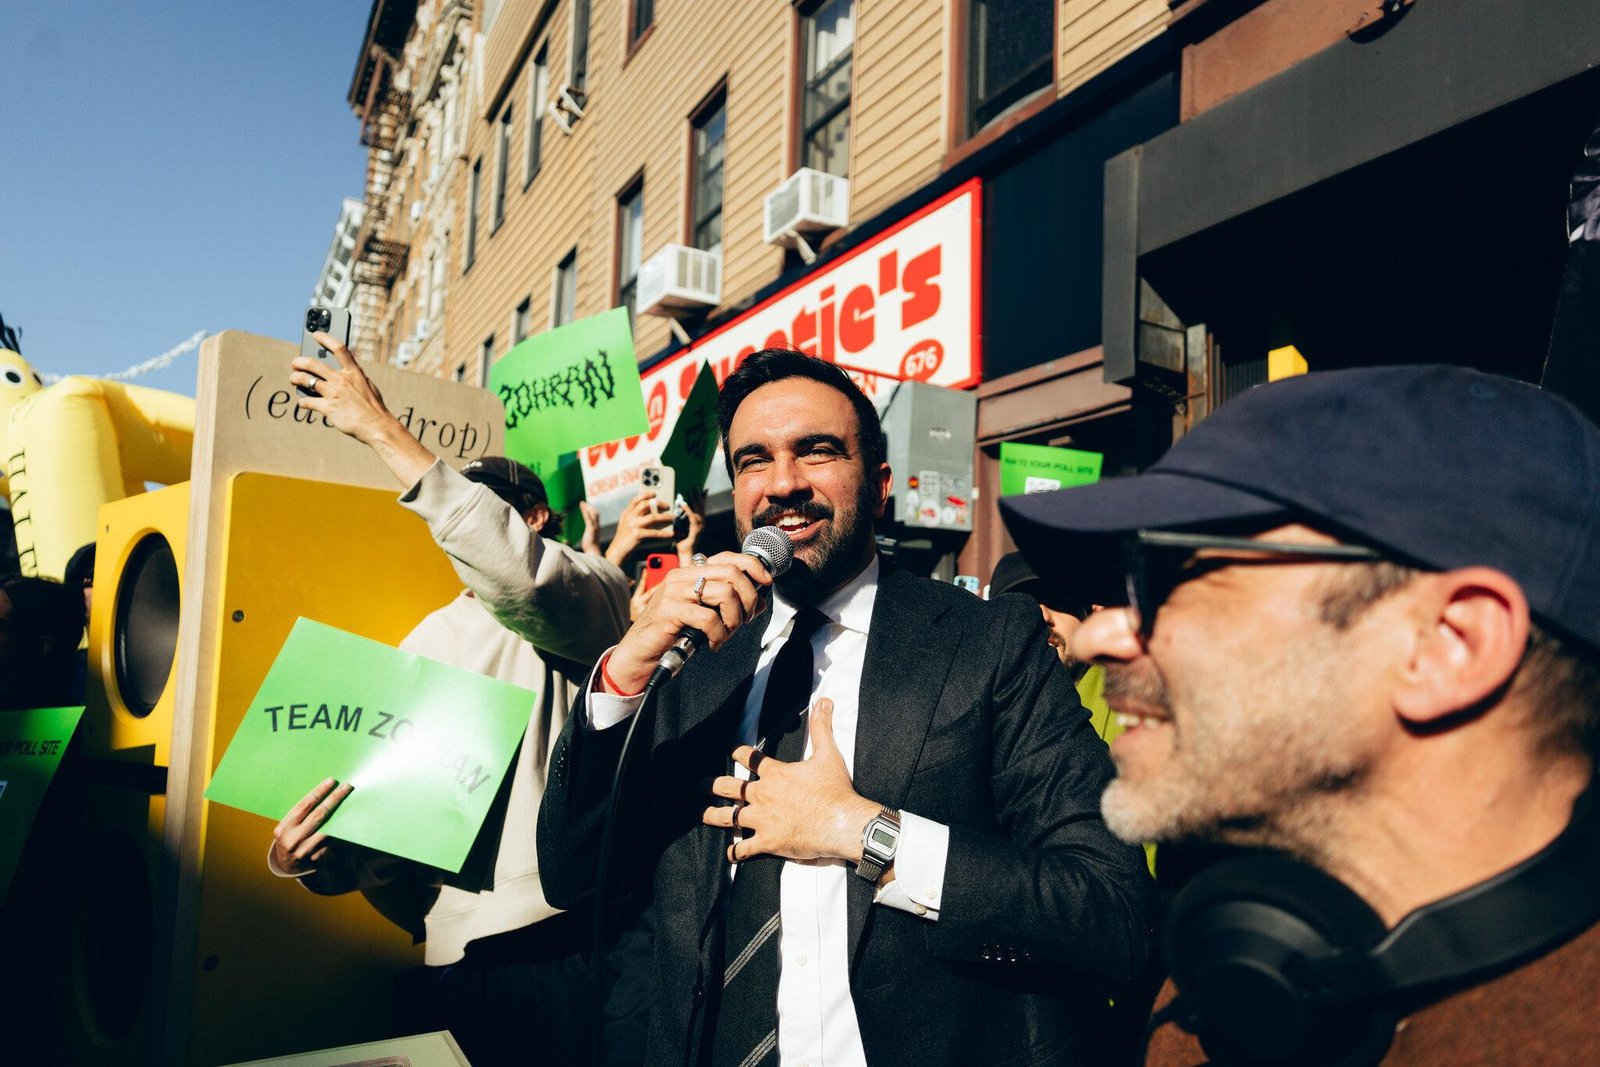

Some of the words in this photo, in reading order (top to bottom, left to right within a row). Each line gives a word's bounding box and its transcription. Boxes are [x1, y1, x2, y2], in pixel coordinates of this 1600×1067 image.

[904, 345, 938, 377] 676
[498, 349, 615, 429] ZOHRAN
[245, 375, 491, 459] (eadrop)
[264, 703, 363, 733] TEAM
[39, 740, 62, 756] SITE
